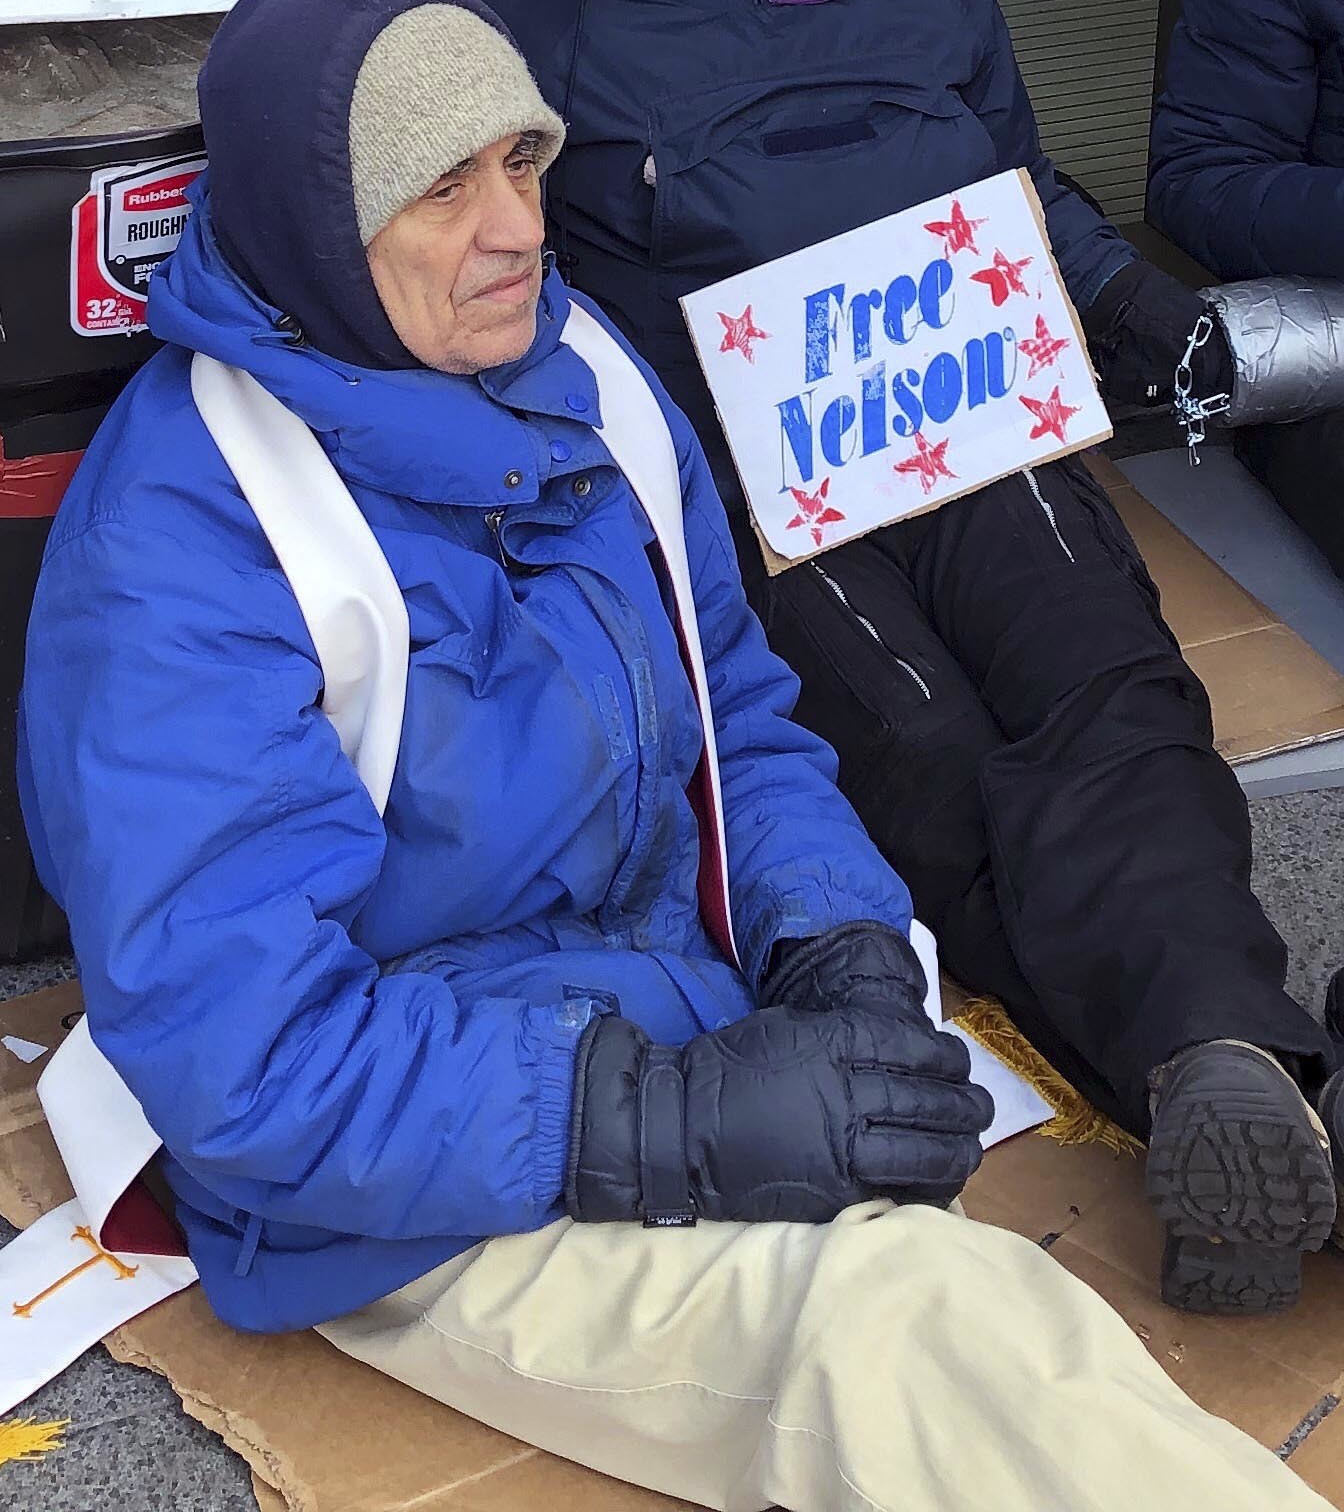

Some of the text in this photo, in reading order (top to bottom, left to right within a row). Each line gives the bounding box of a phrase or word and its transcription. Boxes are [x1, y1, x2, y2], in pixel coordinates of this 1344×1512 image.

[86, 298, 117, 319] 32
[803, 258, 956, 384] Free
[774, 326, 1018, 494] Nelson
